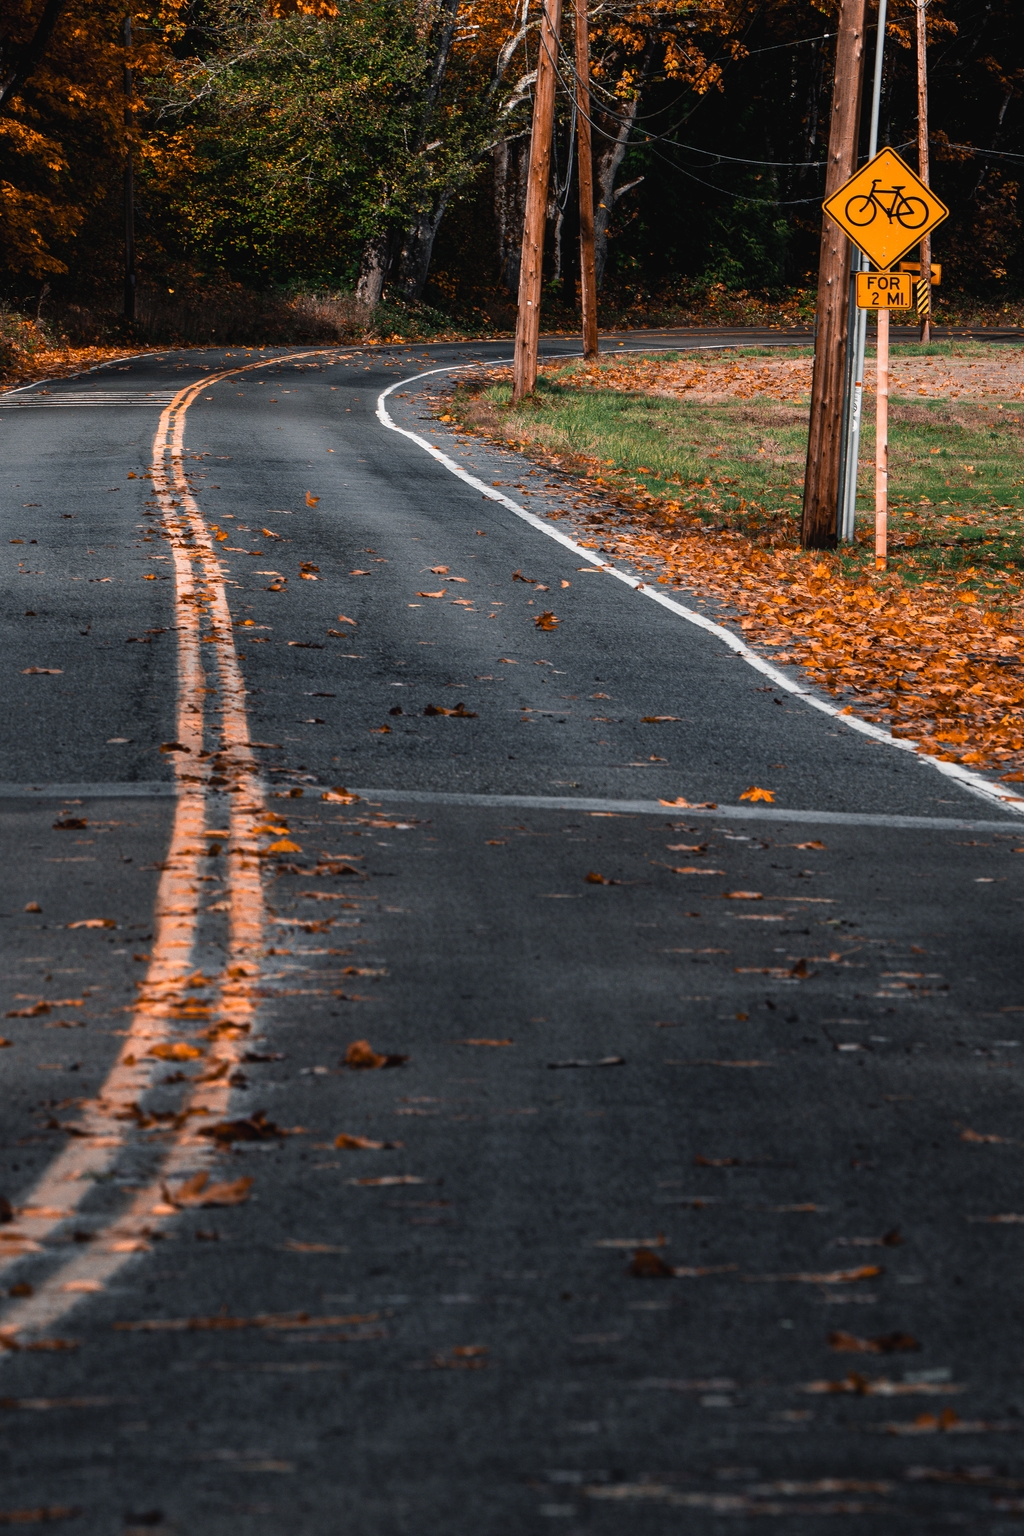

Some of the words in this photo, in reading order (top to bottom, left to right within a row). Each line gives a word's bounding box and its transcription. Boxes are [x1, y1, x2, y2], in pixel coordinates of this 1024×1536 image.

[867, 276, 900, 290] FOR
[871, 292, 880, 305] 2
[887, 292, 908, 306] MI.
